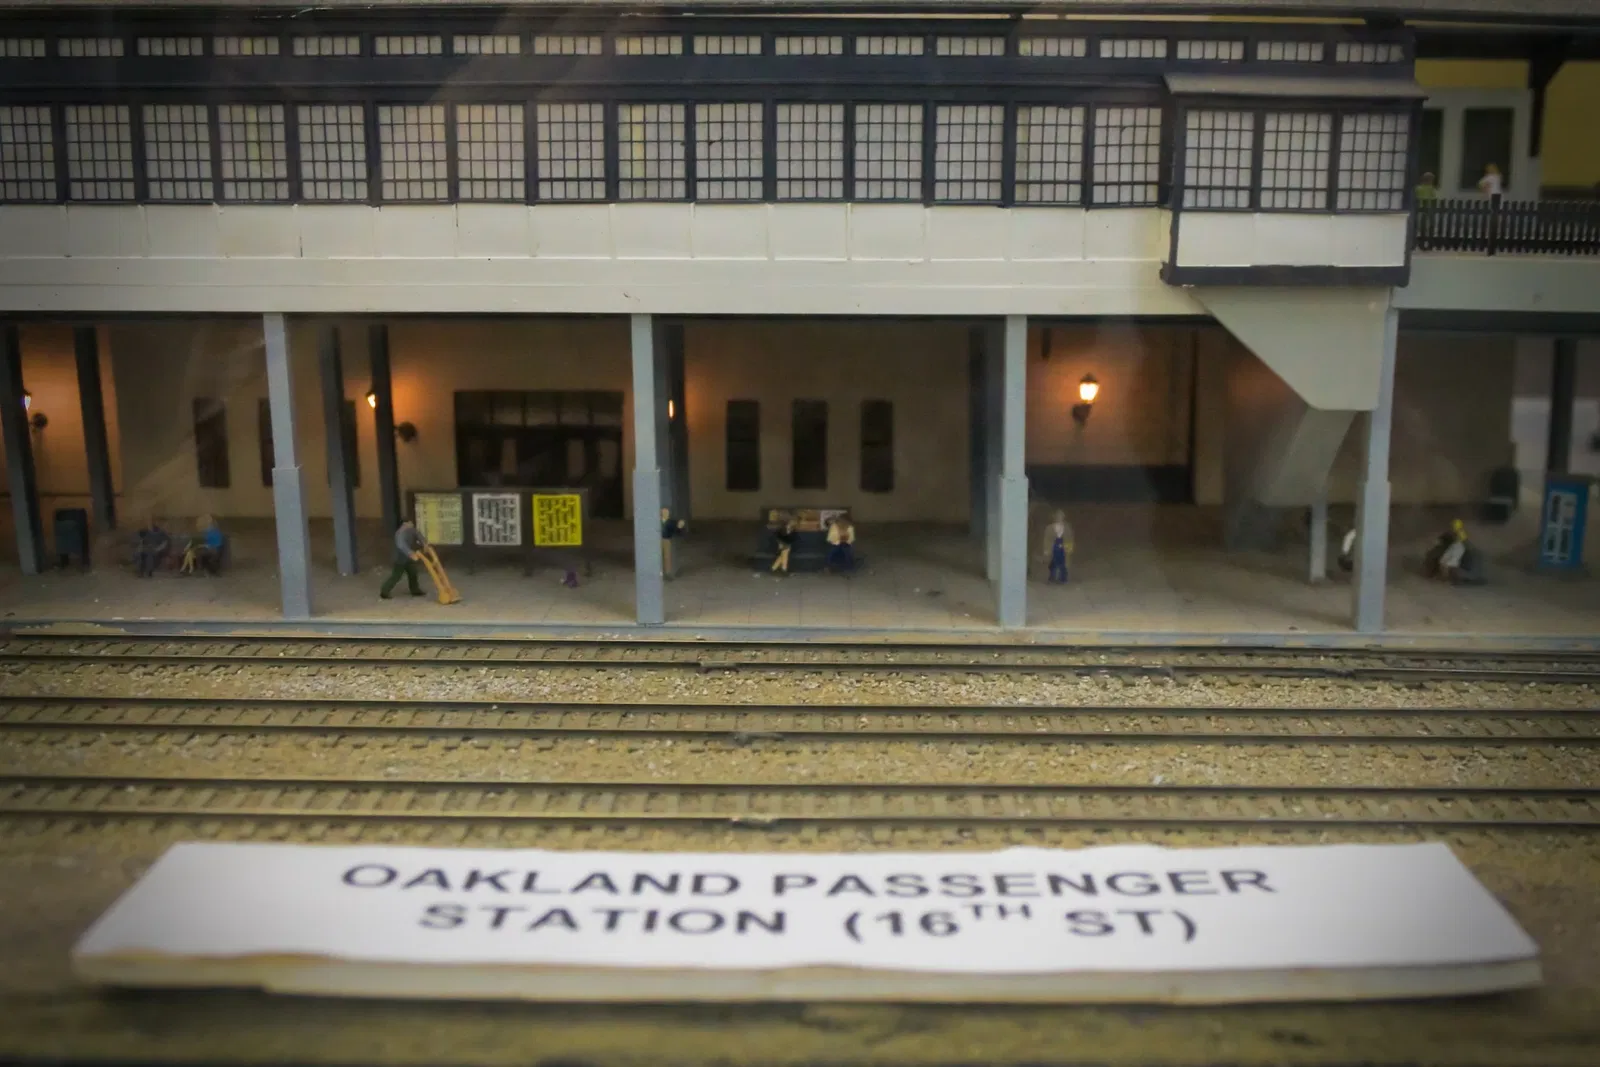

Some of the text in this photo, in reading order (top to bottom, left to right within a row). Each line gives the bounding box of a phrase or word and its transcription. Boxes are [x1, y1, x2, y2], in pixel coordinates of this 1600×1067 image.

[342, 863, 1276, 898] OAKLAND PASSENGER
[421, 902, 1197, 943] STATION (16TH ST)
